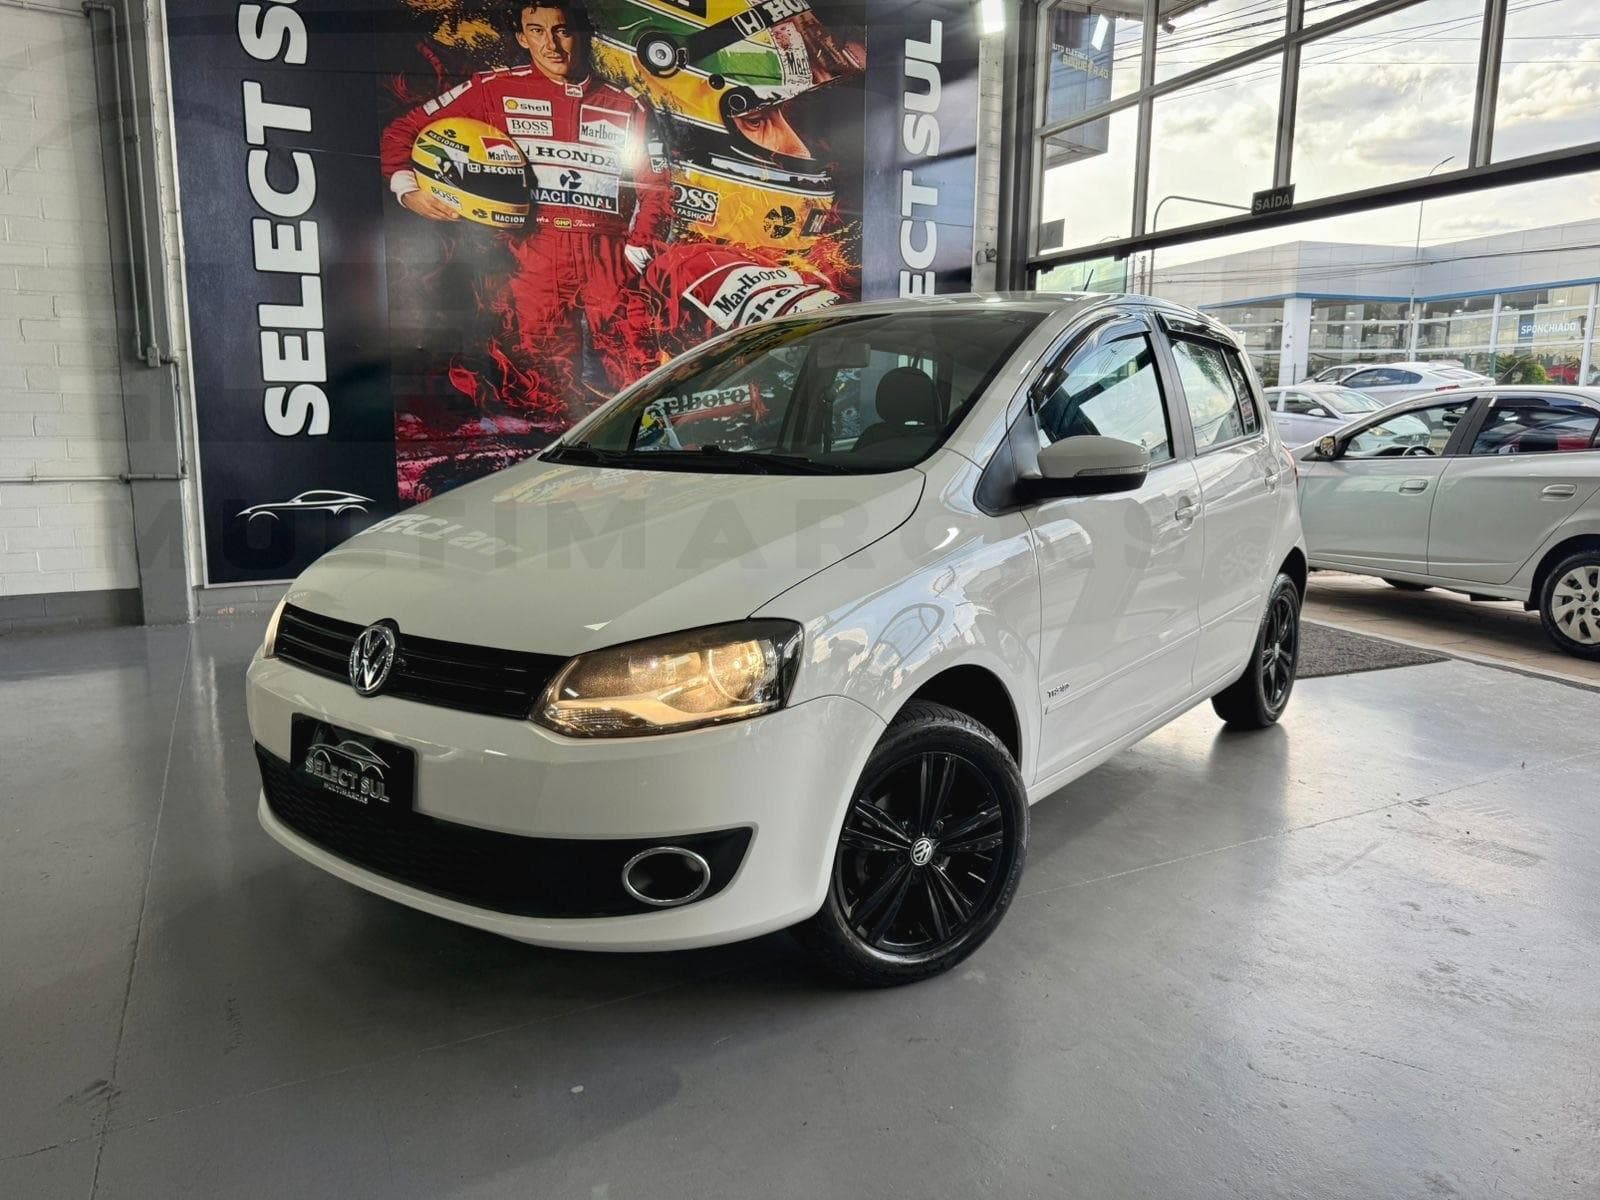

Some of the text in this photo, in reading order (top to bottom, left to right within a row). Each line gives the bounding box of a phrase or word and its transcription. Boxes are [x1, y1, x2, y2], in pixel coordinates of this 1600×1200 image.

[903, 19, 943, 156] SUL
[520, 104, 549, 112] Shell
[511, 119, 549, 130] BOSS
[581, 123, 619, 140] Marlbor
[428, 131, 465, 151] NACIONAL
[536, 146, 619, 169] HONDA
[529, 189, 613, 210] NACIONAL
[1255, 193, 1290, 211] SAÍDA
[238, 0, 331, 437] SELECT S
[677, 207, 713, 222] FASHION
[713, 269, 787, 317] Marlboro
[1521, 322, 1576, 335] SPONCHIADO
[305, 757, 390, 803] SELECT SUL
